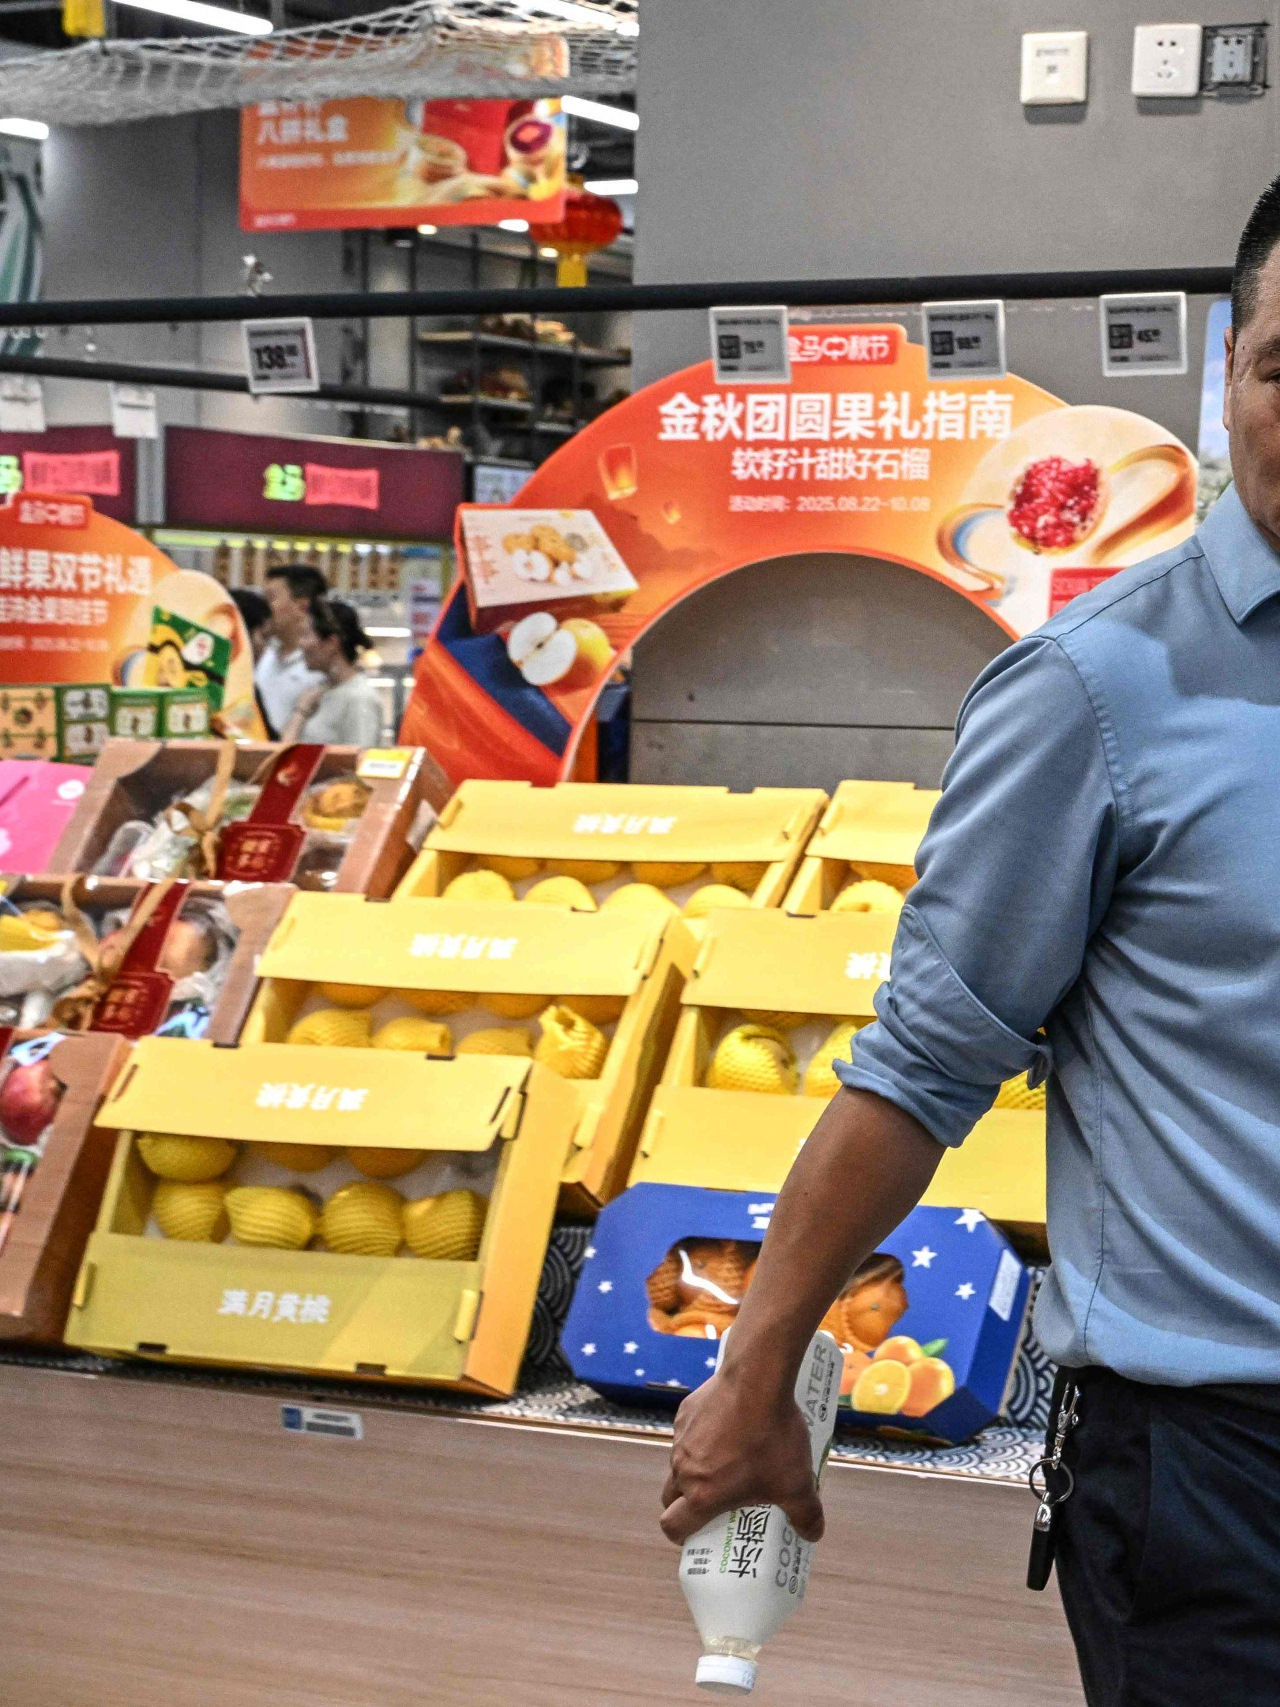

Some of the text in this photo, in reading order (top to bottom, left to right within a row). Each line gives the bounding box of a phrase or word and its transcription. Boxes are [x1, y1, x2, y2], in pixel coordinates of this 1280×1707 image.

[658, 391, 1014, 441] 金秋团圆果礼指南
[731, 447, 931, 481] 软籽汁甜好石榴
[217, 1289, 331, 1323] 满月黄桃
[719, 1525, 734, 1573] COCONUT
